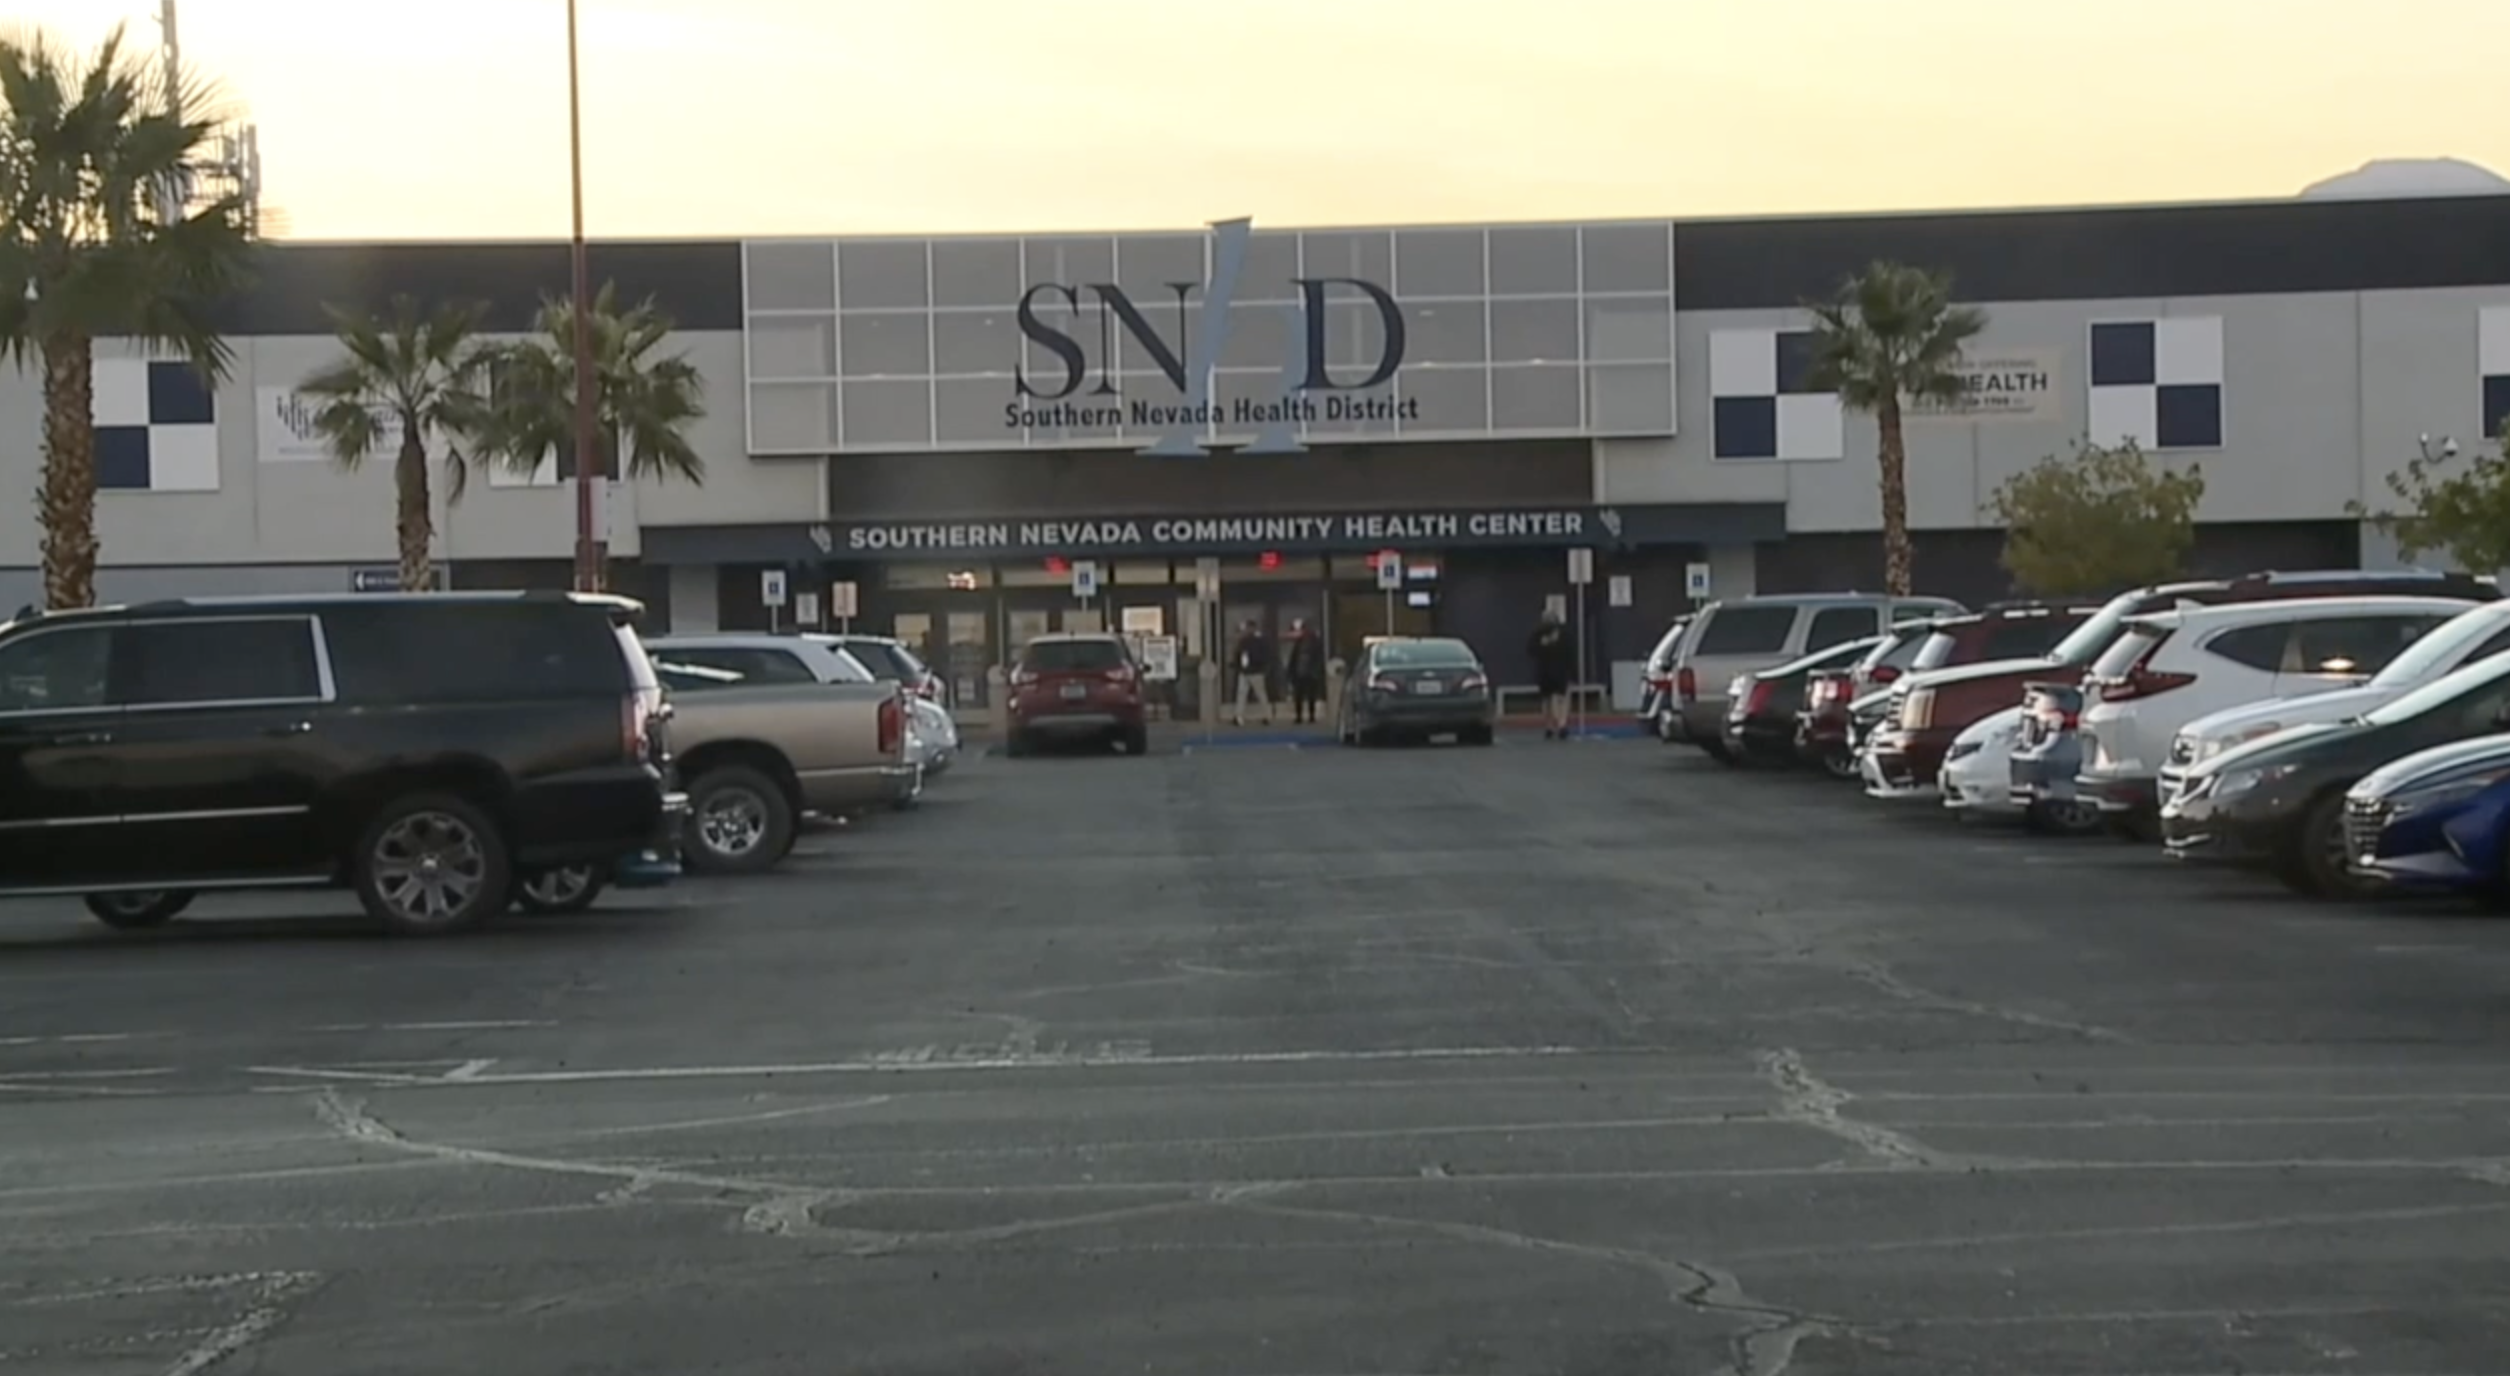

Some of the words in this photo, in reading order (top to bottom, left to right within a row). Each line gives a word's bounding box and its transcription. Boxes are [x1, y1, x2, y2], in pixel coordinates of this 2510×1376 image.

[1005, 402, 1123, 428] Southern
[1131, 399, 1225, 426] Nevada
[1234, 396, 1317, 424] Health
[1326, 393, 1420, 421] District
[849, 525, 1008, 550] SOUTHERN
[1020, 521, 1142, 546] NEVADA
[1152, 517, 1333, 543] COMMUNITY
[1345, 513, 1459, 539] HEALTH
[1469, 511, 1583, 537] CENTER
